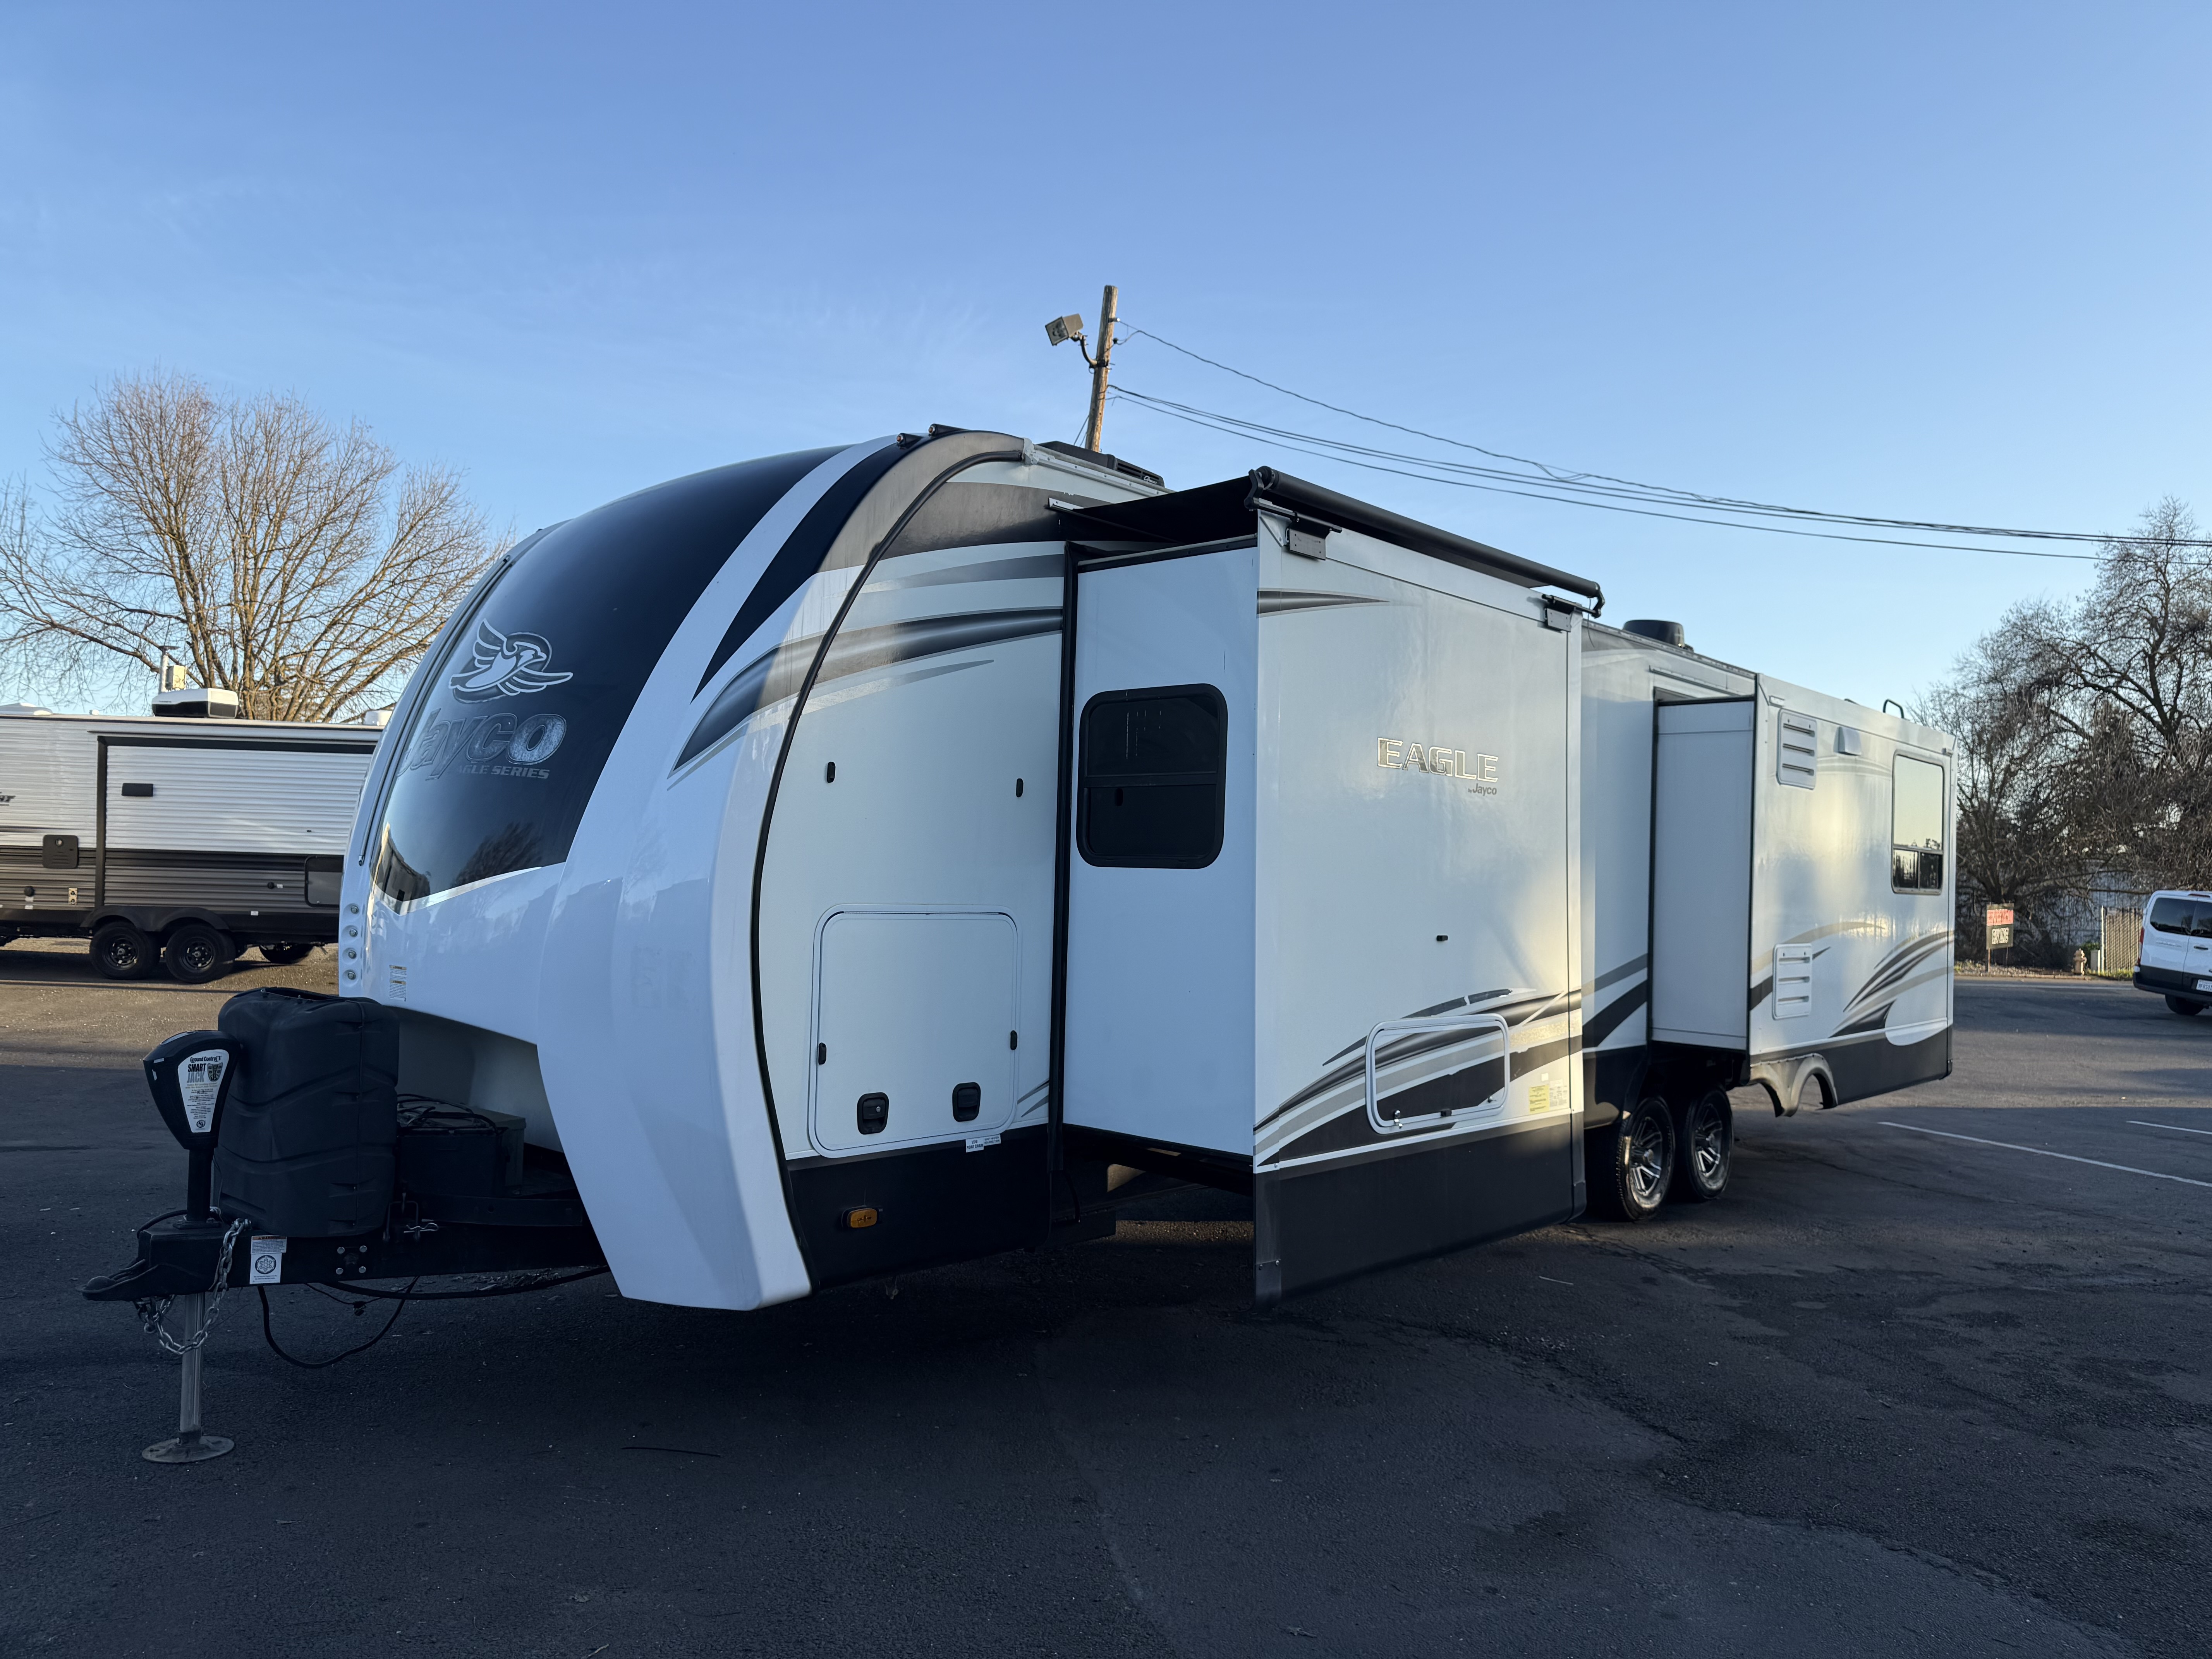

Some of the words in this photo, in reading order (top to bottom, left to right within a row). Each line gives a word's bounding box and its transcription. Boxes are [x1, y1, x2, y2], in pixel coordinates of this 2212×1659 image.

[1377, 737, 1499, 783] EAGLE
[491, 766, 550, 779] SERIES
[1472, 783, 1497, 796] Jayco
[188, 1063, 206, 1072] SMART
[187, 1072, 204, 1083] JACK
